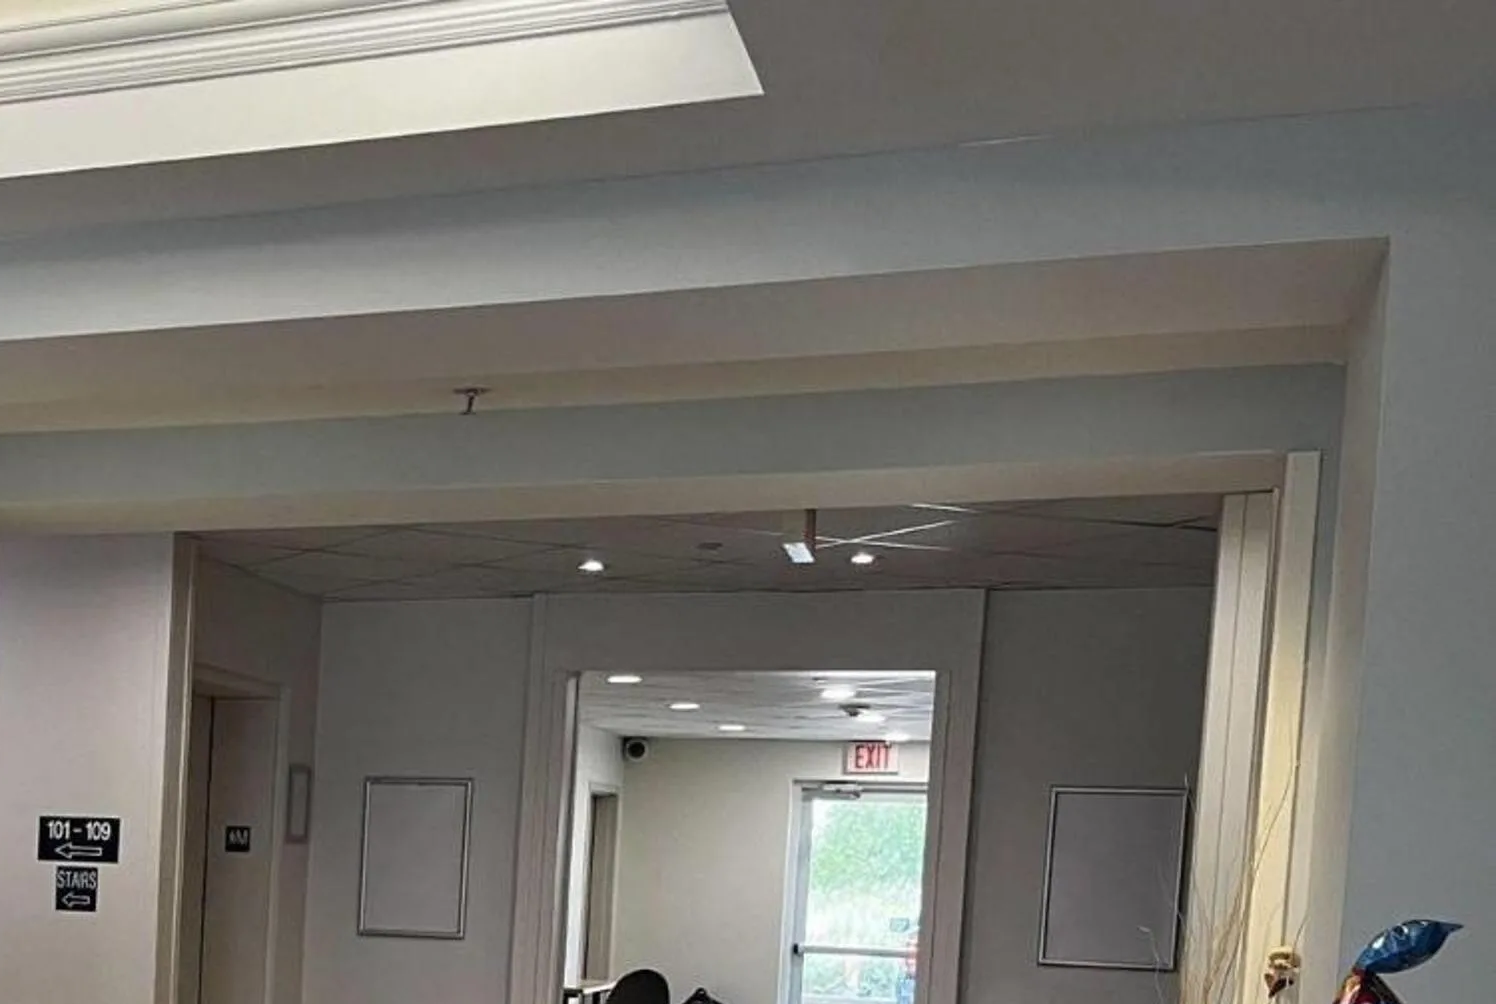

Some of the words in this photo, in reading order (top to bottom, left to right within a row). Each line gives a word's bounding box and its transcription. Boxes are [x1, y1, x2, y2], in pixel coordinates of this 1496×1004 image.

[855, 743, 889, 769] EXIT
[47, 820, 71, 840] 101
[86, 821, 111, 841] 109
